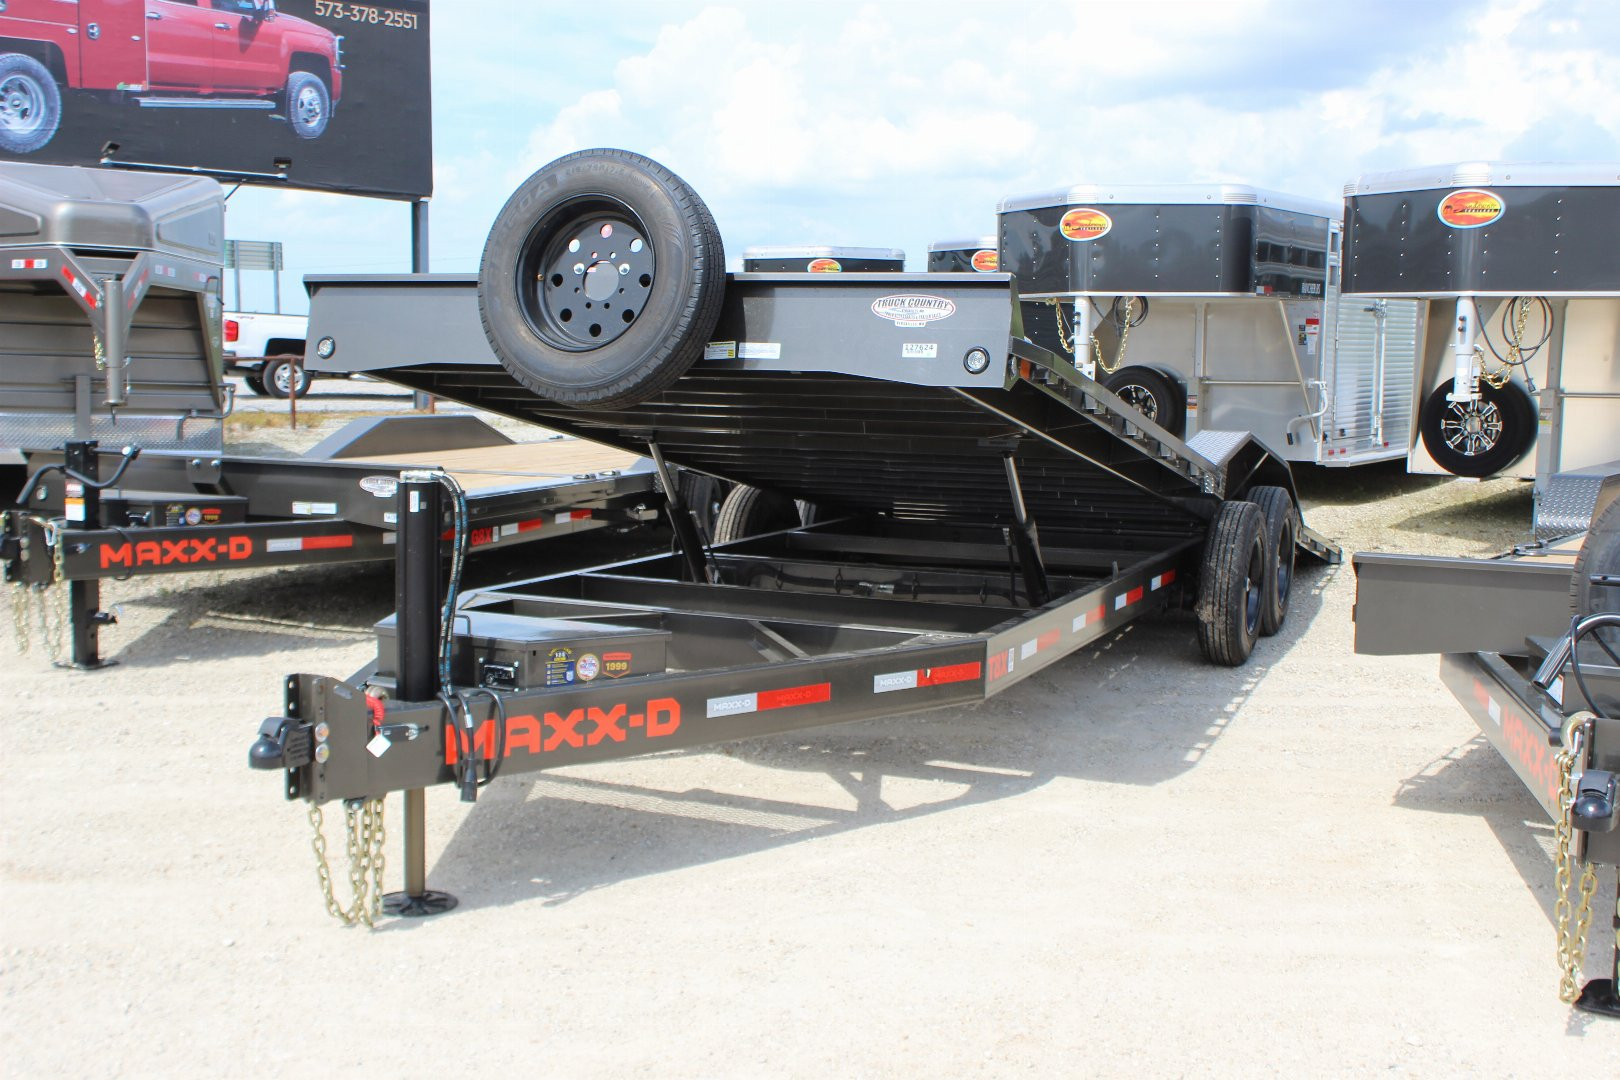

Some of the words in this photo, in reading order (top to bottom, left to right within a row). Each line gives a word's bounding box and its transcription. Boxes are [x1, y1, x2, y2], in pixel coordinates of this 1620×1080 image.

[315, 0, 418, 30] 573-378-2551
[877, 298, 906, 308] TRUCK
[907, 298, 949, 309] COUNTRY
[100, 536, 253, 568] MAXX-D
[713, 699, 751, 712] MAXX-D
[445, 697, 681, 765] MAXX-D
